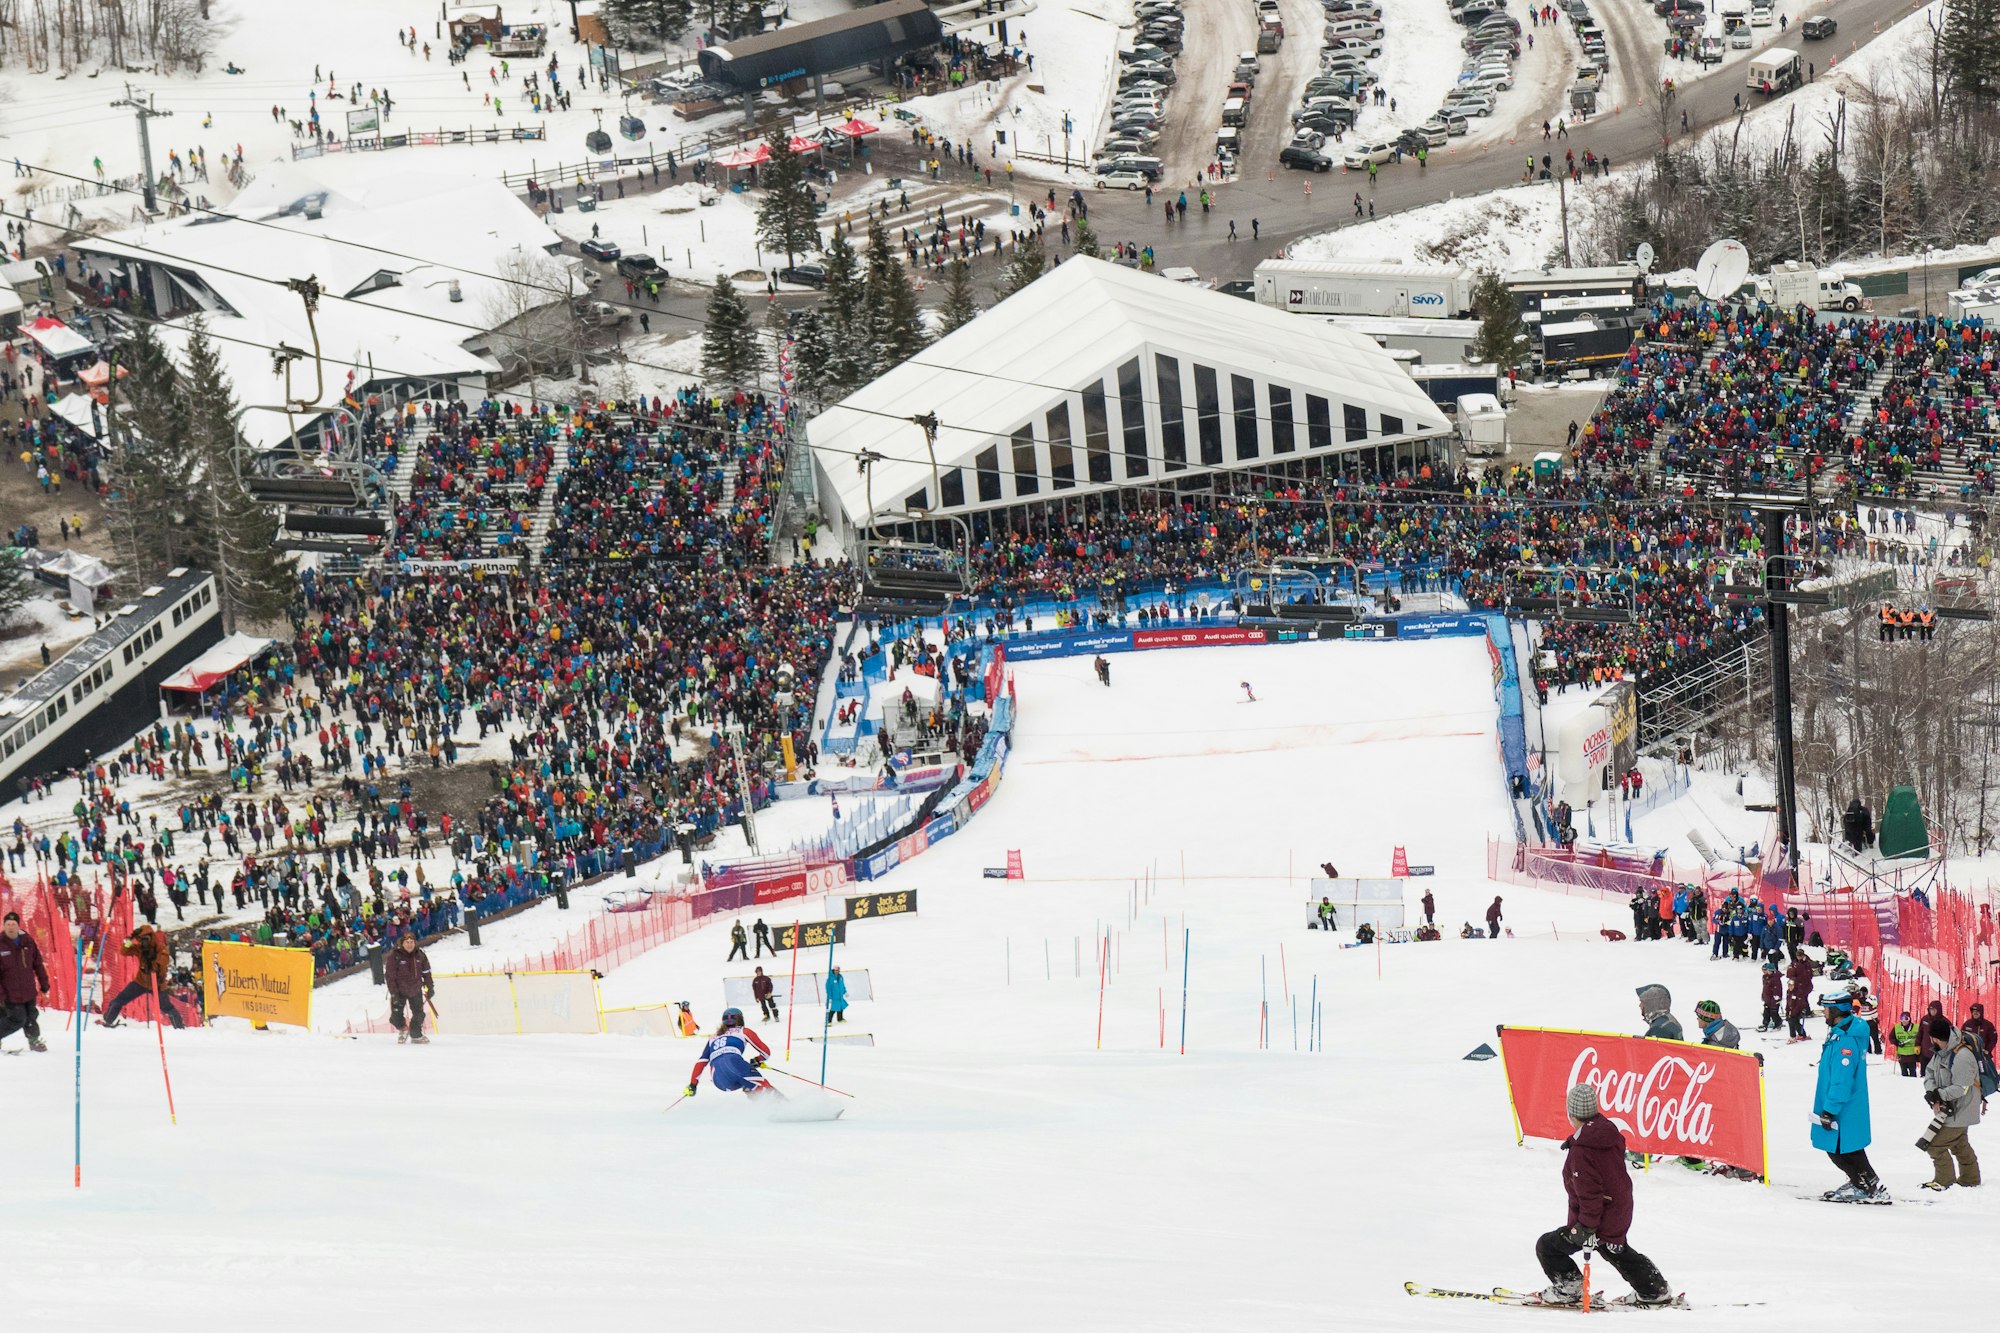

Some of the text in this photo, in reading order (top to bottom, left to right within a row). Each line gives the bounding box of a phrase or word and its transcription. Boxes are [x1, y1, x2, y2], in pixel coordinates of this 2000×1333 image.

[1412, 295, 1438, 305] SNY
[1583, 726, 1611, 753] OCHSN
[1589, 745, 1608, 770] SPORT
[758, 888, 771, 896] Audi
[877, 896, 894, 906] Jack
[877, 902, 907, 915] Wolfskin
[805, 926, 823, 937] Jack
[805, 934, 837, 946] Wolfskn
[228, 969, 290, 995] Liberty Mutual
[242, 1000, 278, 1015] INSURANCE
[713, 1036, 727, 1050] 36
